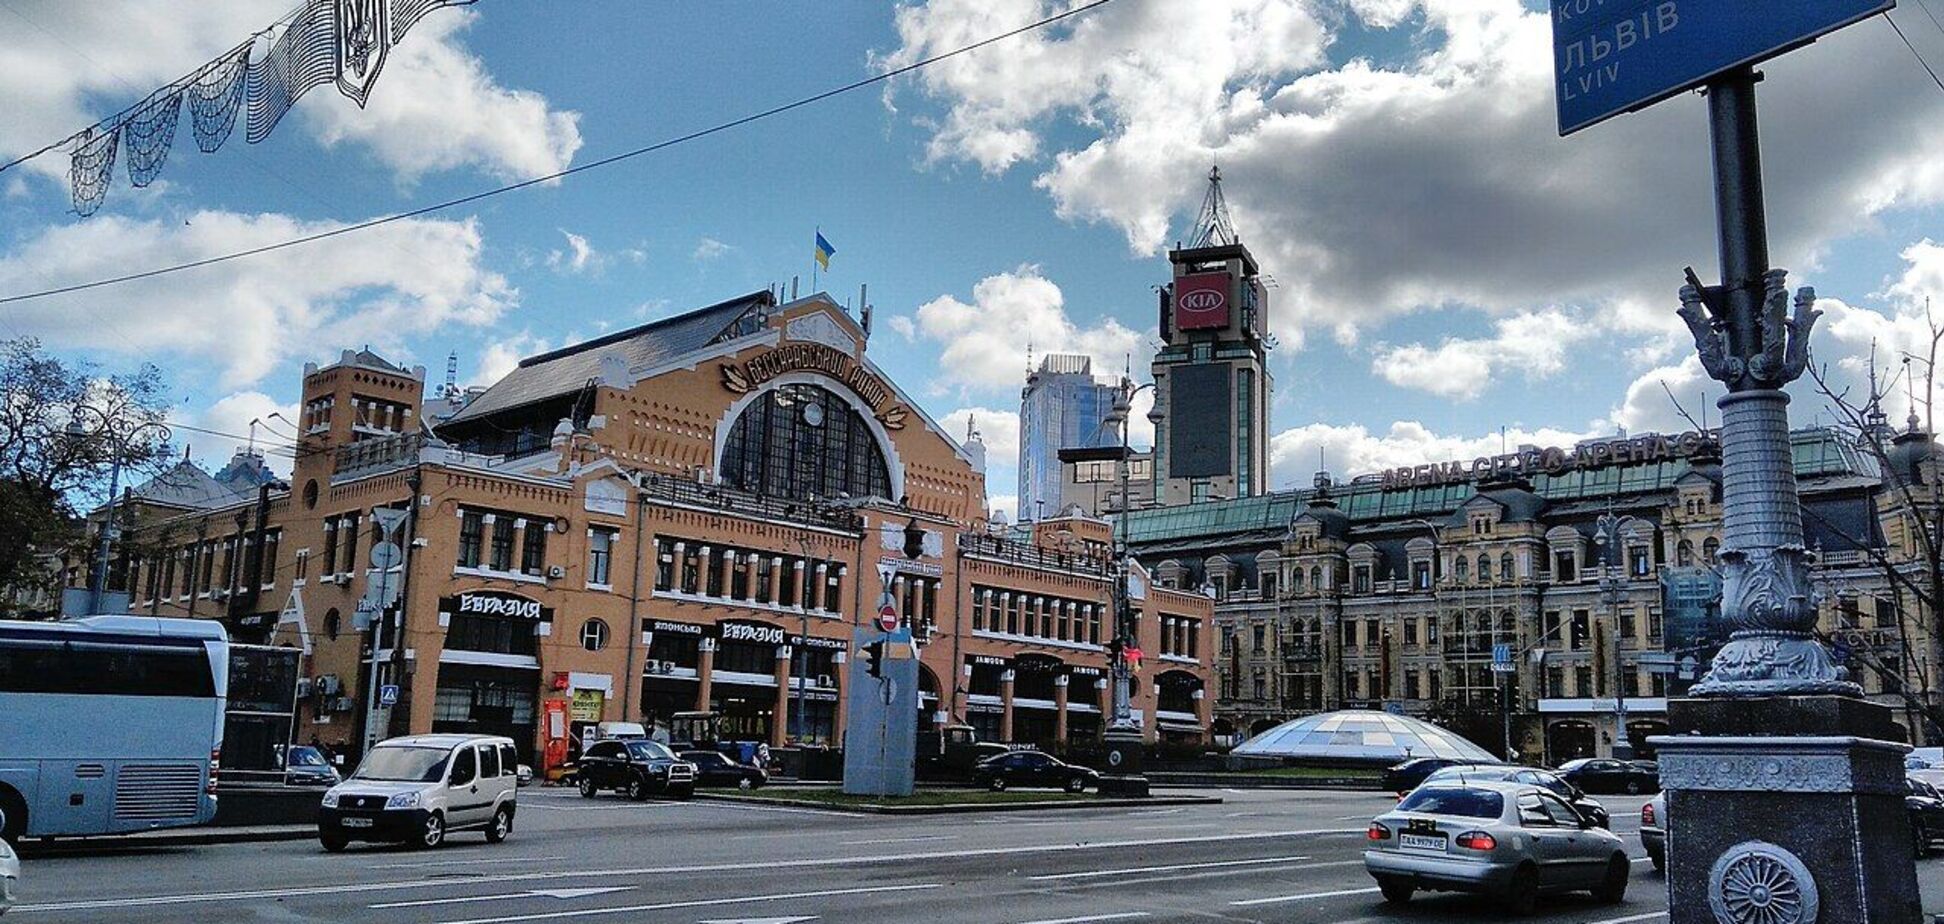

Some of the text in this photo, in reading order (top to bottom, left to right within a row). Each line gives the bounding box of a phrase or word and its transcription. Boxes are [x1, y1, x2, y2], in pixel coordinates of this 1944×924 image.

[1558, 0, 1604, 23] KO
[1563, 1, 1680, 74] ЛЬВІВ
[1563, 61, 1620, 101] LVIV
[1187, 294, 1217, 308] KIA
[1573, 432, 1671, 470] АРЕНА
[1380, 452, 1533, 492] ARENA CITY
[459, 593, 541, 619] ЕВРАЗИЯ
[722, 622, 785, 644] ЕВРАЗИЯ
